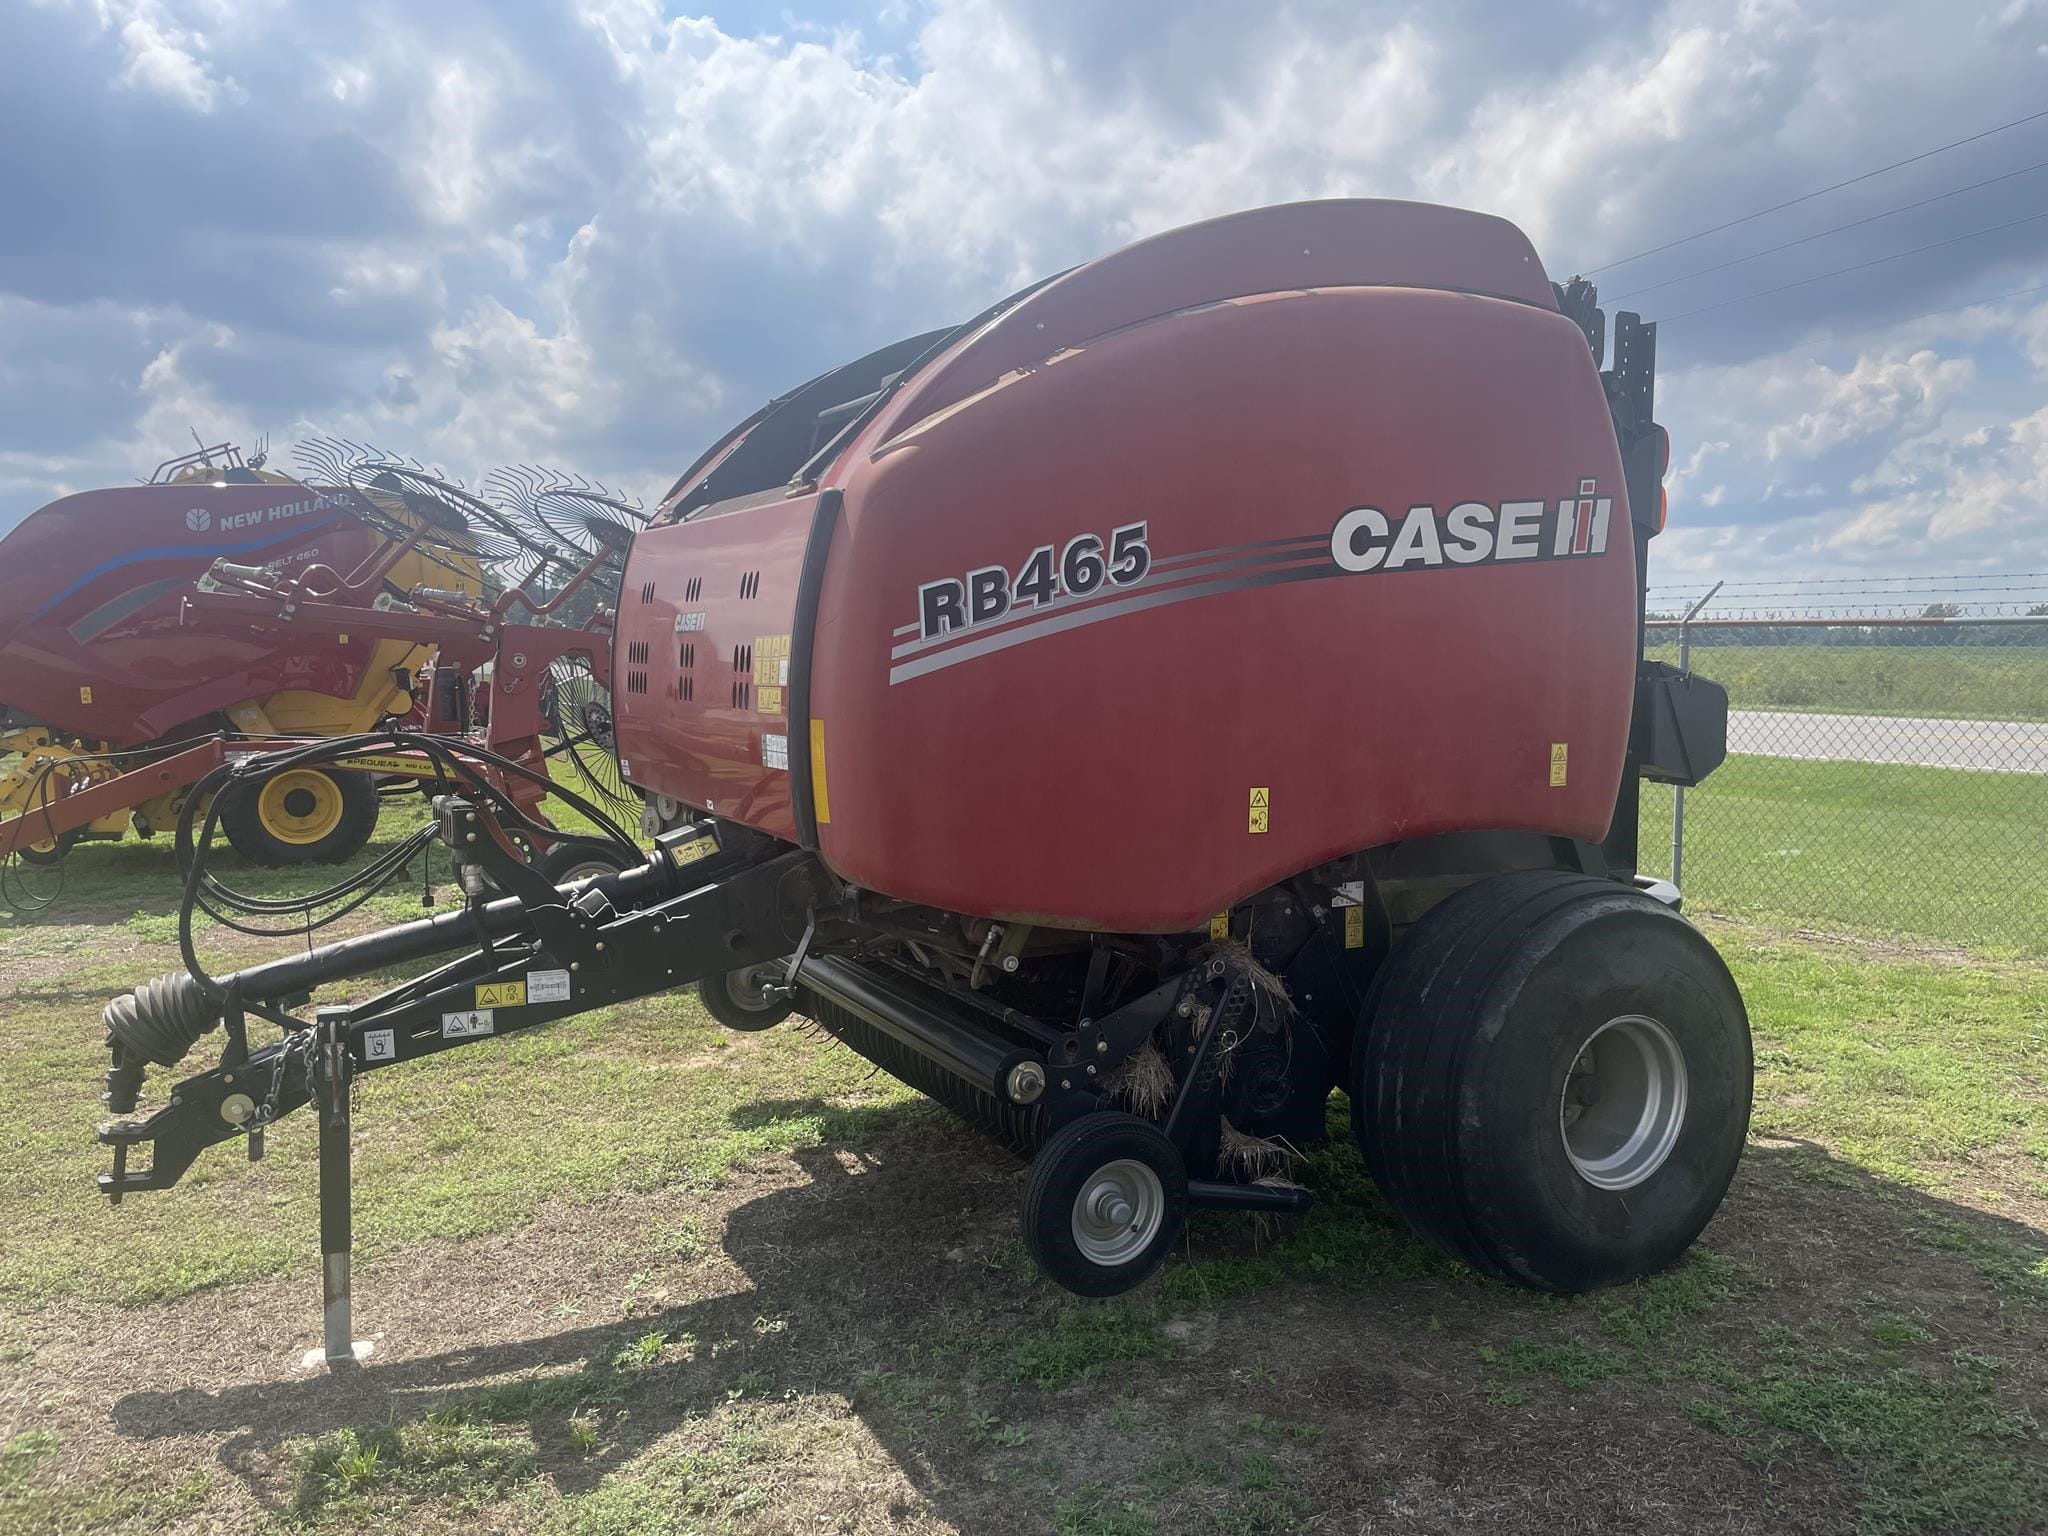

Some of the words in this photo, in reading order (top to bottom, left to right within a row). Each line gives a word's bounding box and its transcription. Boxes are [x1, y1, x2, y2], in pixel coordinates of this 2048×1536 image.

[220, 510, 263, 532] NEW
[1331, 502, 1544, 572] CASE
[918, 520, 1152, 642] RB465
